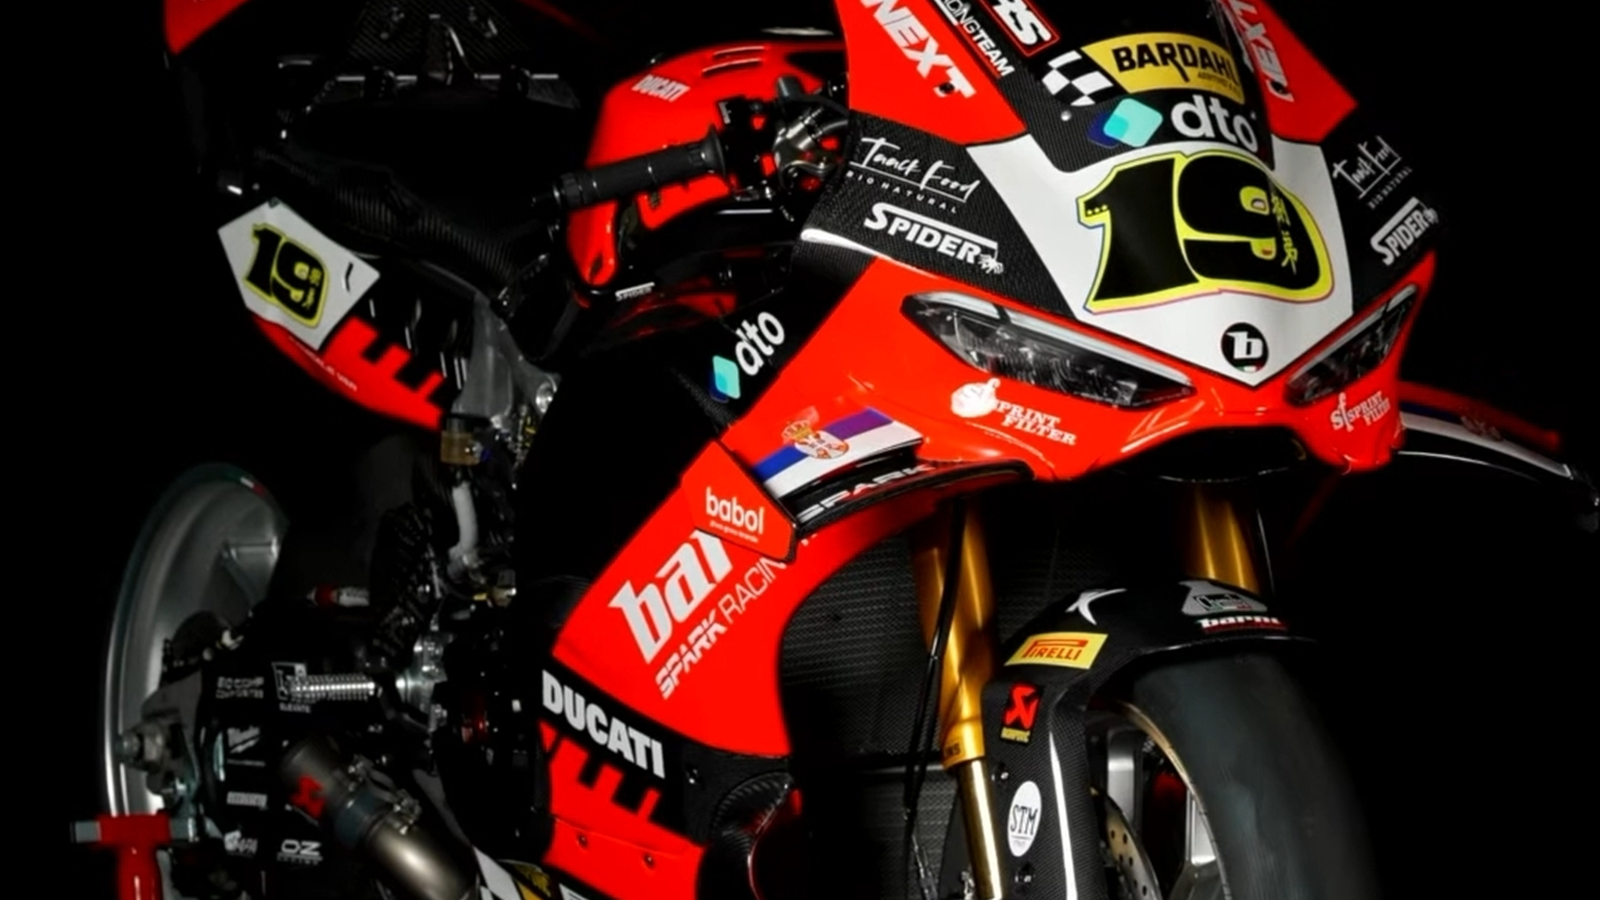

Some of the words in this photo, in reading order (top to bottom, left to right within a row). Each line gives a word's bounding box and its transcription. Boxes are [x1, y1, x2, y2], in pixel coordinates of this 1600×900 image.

[972, 28, 1015, 77] TEAM
[1111, 42, 1240, 88] BARDAHL
[631, 73, 691, 104] DUCATI
[1171, 94, 1258, 153] dto
[881, 182, 957, 214] NATURAL
[864, 202, 999, 265] SPIDER
[1076, 149, 1334, 315] 19
[1370, 197, 1429, 265] SPIDER
[244, 222, 330, 329] 19
[735, 312, 785, 376] dto
[1001, 413, 1077, 446] FILTER
[706, 486, 764, 536] babol
[655, 608, 728, 701] SPARK
[718, 556, 788, 624] RACIN
[1021, 639, 1088, 661] PIRELLI
[542, 669, 665, 779] DUCATI
[1011, 804, 1038, 836] STM
